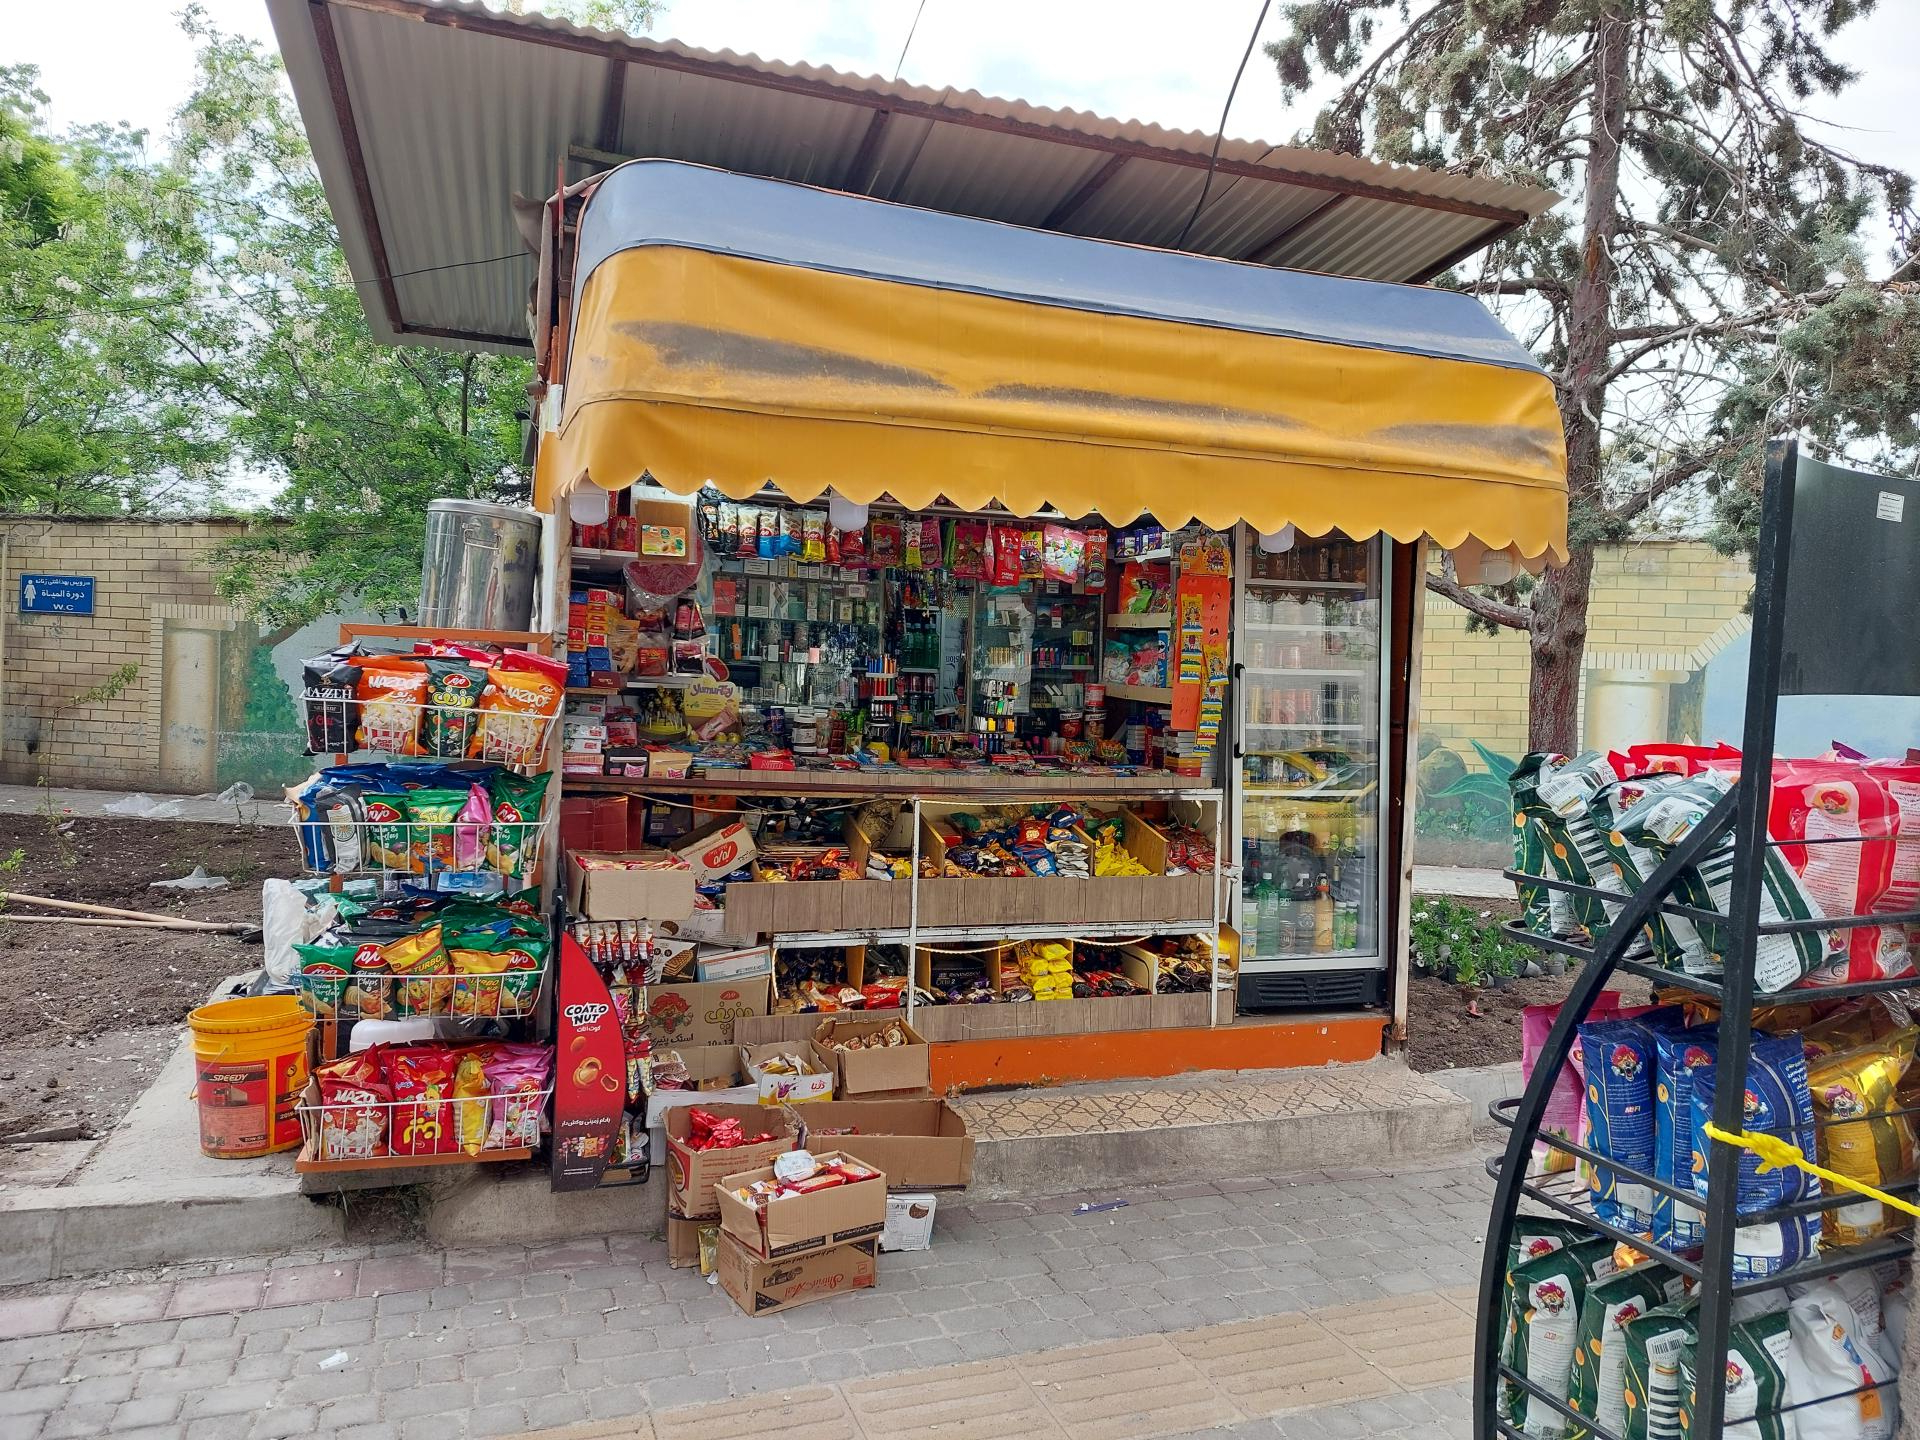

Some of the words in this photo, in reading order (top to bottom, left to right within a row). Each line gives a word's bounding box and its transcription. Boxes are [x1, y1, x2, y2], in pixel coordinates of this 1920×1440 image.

[414, 954, 443, 973] TURBO
[470, 978, 499, 986] TRBO
[573, 1013, 599, 1025] NUT
[212, 1073, 249, 1082] SPEEDY
[811, 1273, 844, 1290] Shirin
